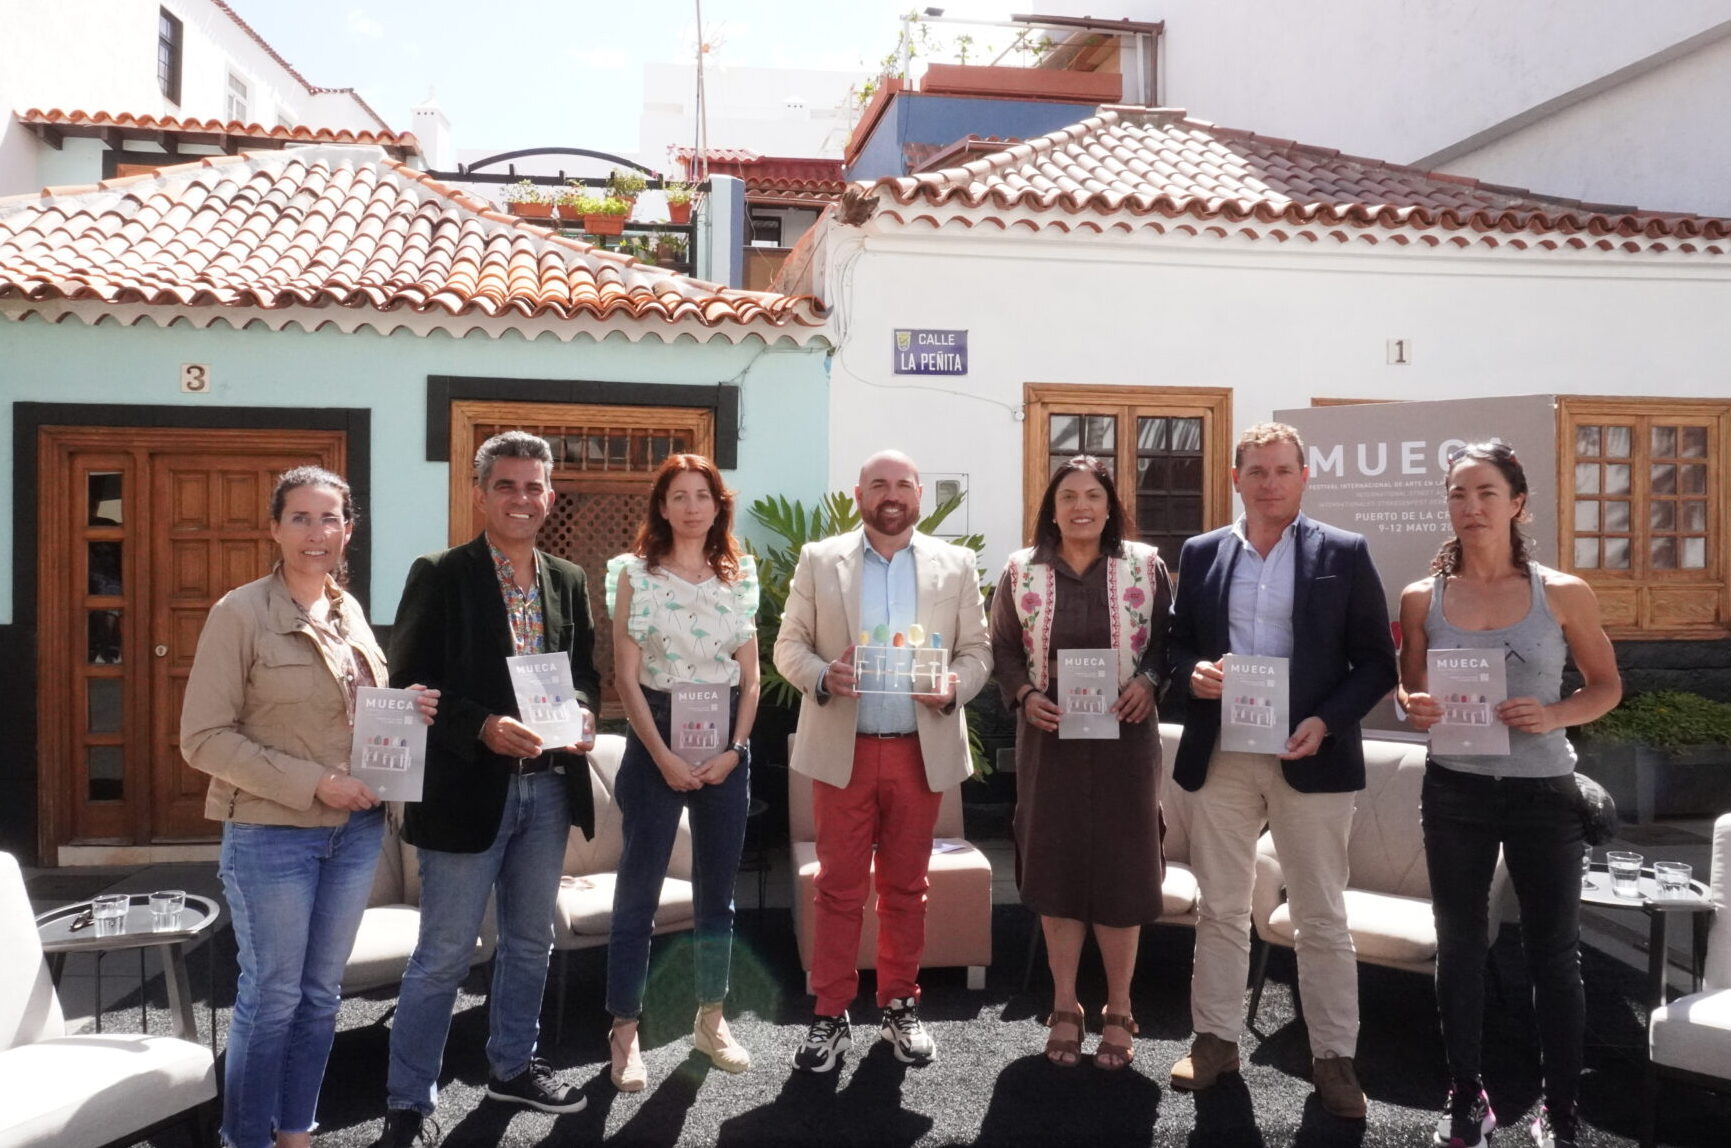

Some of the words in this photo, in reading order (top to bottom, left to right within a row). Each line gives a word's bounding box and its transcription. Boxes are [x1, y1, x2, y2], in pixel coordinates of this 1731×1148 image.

[918, 333, 956, 346] CALLE
[1395, 340, 1406, 363] 1
[901, 352, 916, 371] LA
[921, 350, 962, 371] PEÑITA
[186, 365, 205, 391] 3
[1308, 438, 1502, 478] MUEC
[1355, 512, 1398, 521] PUERTO
[1402, 511, 1416, 520] DE
[1419, 511, 1433, 520] LA
[1378, 523, 1402, 532] 9-12
[1406, 523, 1437, 532] MAYO
[1065, 657, 1105, 666] MUECA
[1437, 658, 1489, 668] MUECA
[516, 663, 557, 673] MUECA
[1231, 664, 1275, 675] MUECA
[679, 691, 719, 700] MUECA
[366, 698, 414, 710] MUECA
